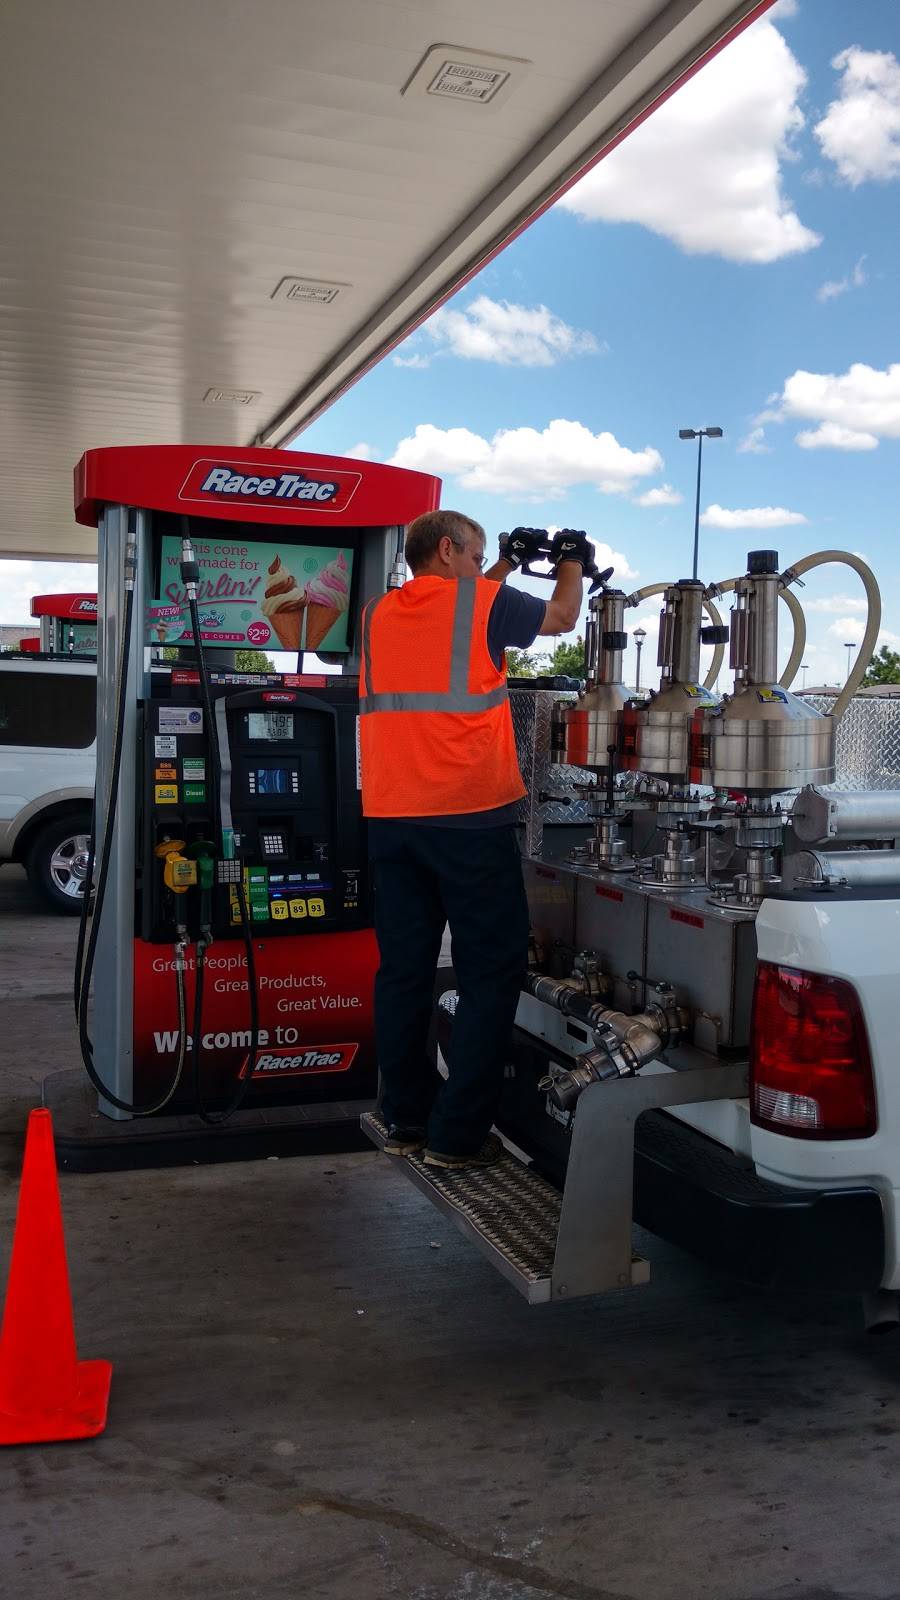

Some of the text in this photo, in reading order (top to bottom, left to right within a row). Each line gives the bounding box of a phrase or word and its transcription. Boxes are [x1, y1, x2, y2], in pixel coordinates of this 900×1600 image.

[201, 467, 335, 501] RaceTrac
[214, 545, 248, 556] cone
[197, 557, 258, 570] made for
[274, 906, 285, 915] 87
[293, 905, 304, 914] 89
[311, 904, 322, 913] 93
[214, 973, 327, 992] Grea Products,
[277, 994, 362, 1012] Great Value.
[153, 1025, 299, 1054] Wecome to
[254, 1051, 341, 1071] RaceTrac
